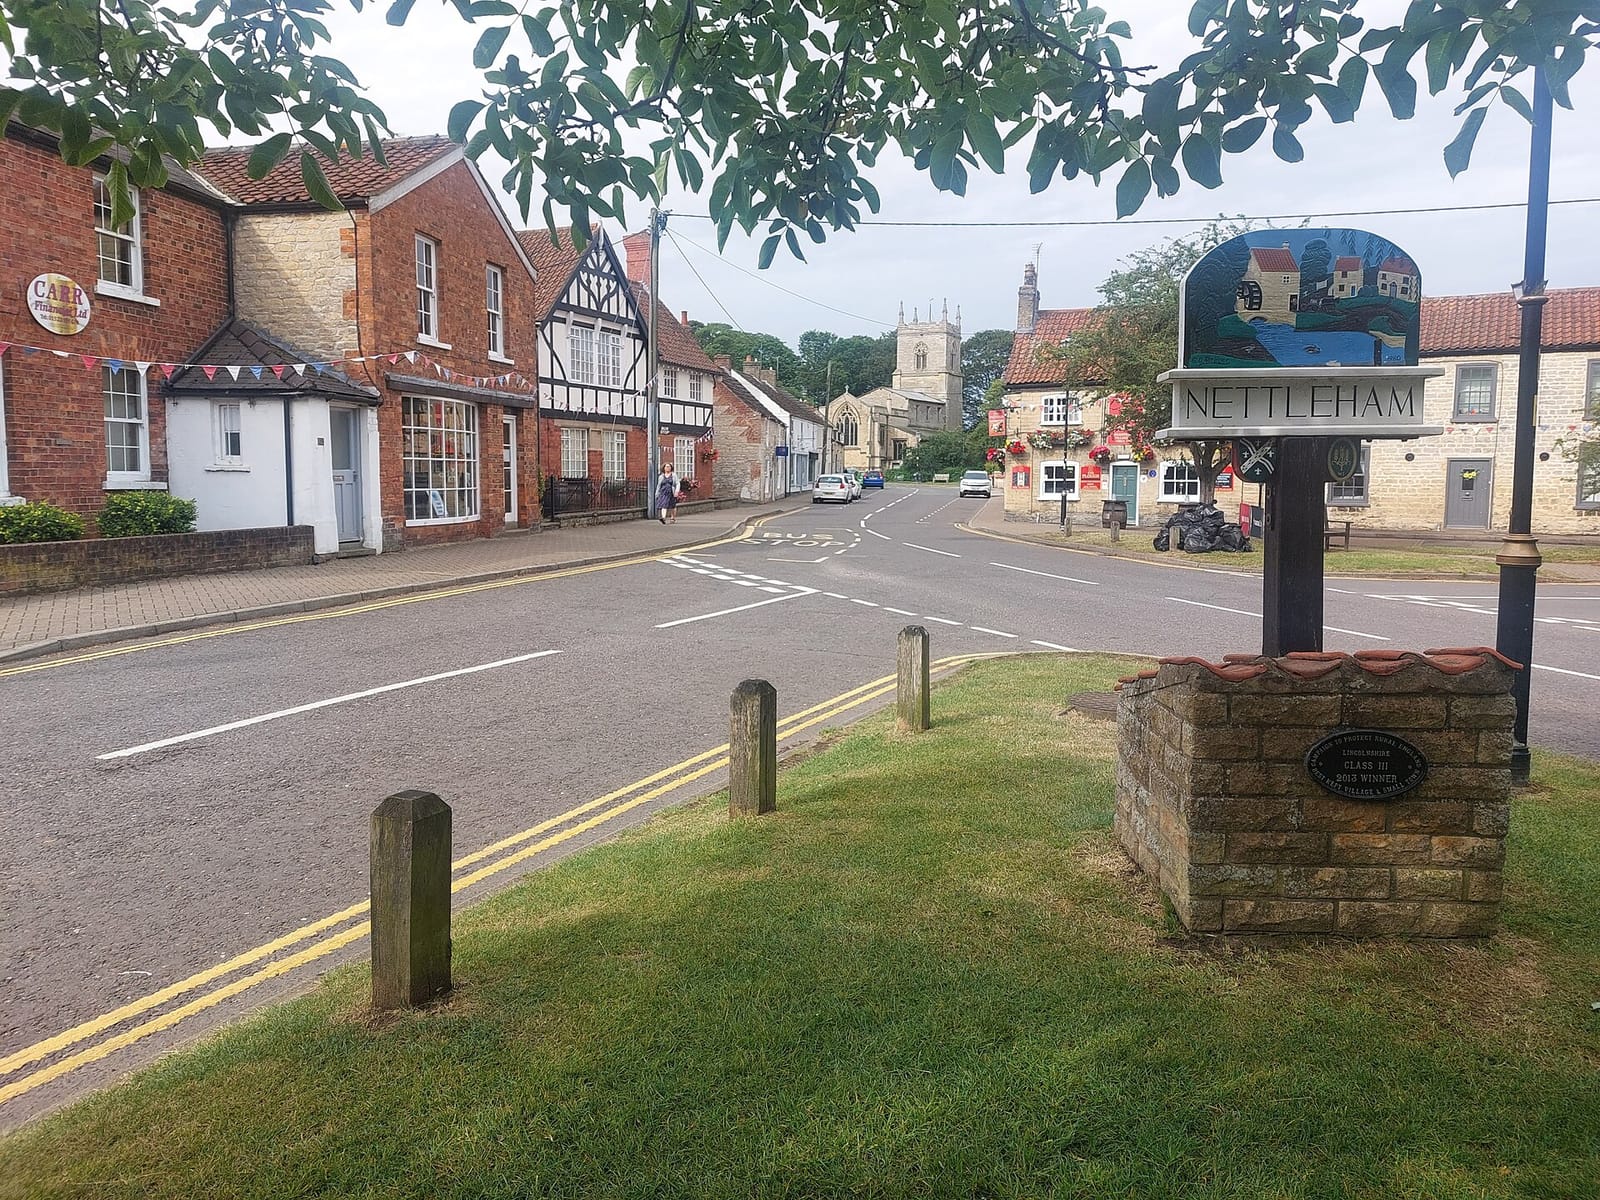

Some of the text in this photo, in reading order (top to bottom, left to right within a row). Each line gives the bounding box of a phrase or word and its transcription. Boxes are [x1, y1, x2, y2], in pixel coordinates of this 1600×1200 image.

[34, 280, 83, 305] CARR
[72, 307, 88, 319] Ltd
[1186, 384, 1415, 420] NETTLEHAM
[762, 532, 834, 540] BUS
[737, 539, 845, 547] STOP
[1310, 742, 1333, 767] CAMPAIGN
[1343, 735, 1372, 743] PROTECT
[1374, 735, 1396, 746] RURAL
[1342, 749, 1391, 757] LINCOLNSHIRE
[1344, 760, 1388, 771] CLASS III
[1311, 767, 1326, 781] BEST
[1325, 777, 1342, 790] KEPT
[1344, 785, 1374, 795] VILLAGE
[1382, 782, 1405, 794] SMALL
[1336, 773, 1398, 784] 2013 WINNER
